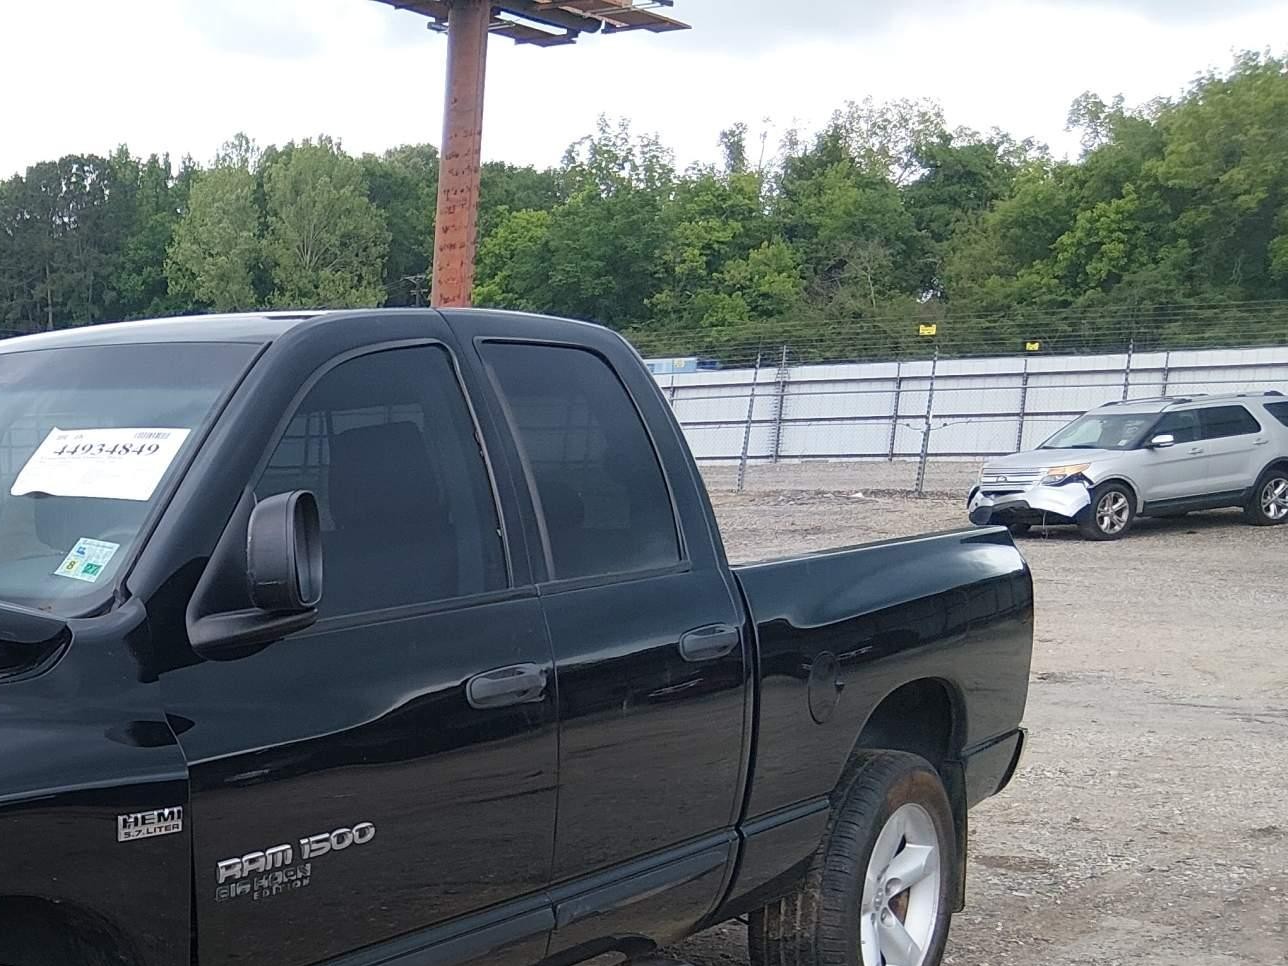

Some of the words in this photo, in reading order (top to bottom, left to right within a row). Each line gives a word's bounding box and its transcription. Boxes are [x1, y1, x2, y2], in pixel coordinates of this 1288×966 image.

[53, 443, 160, 456] 44934849
[122, 808, 182, 829] HEMI
[124, 829, 143, 839] 5.7
[146, 823, 180, 835] LITER
[216, 843, 294, 884] RAM
[299, 821, 376, 860] 1500
[216, 879, 251, 901] BIG
[253, 863, 312, 891] HORN
